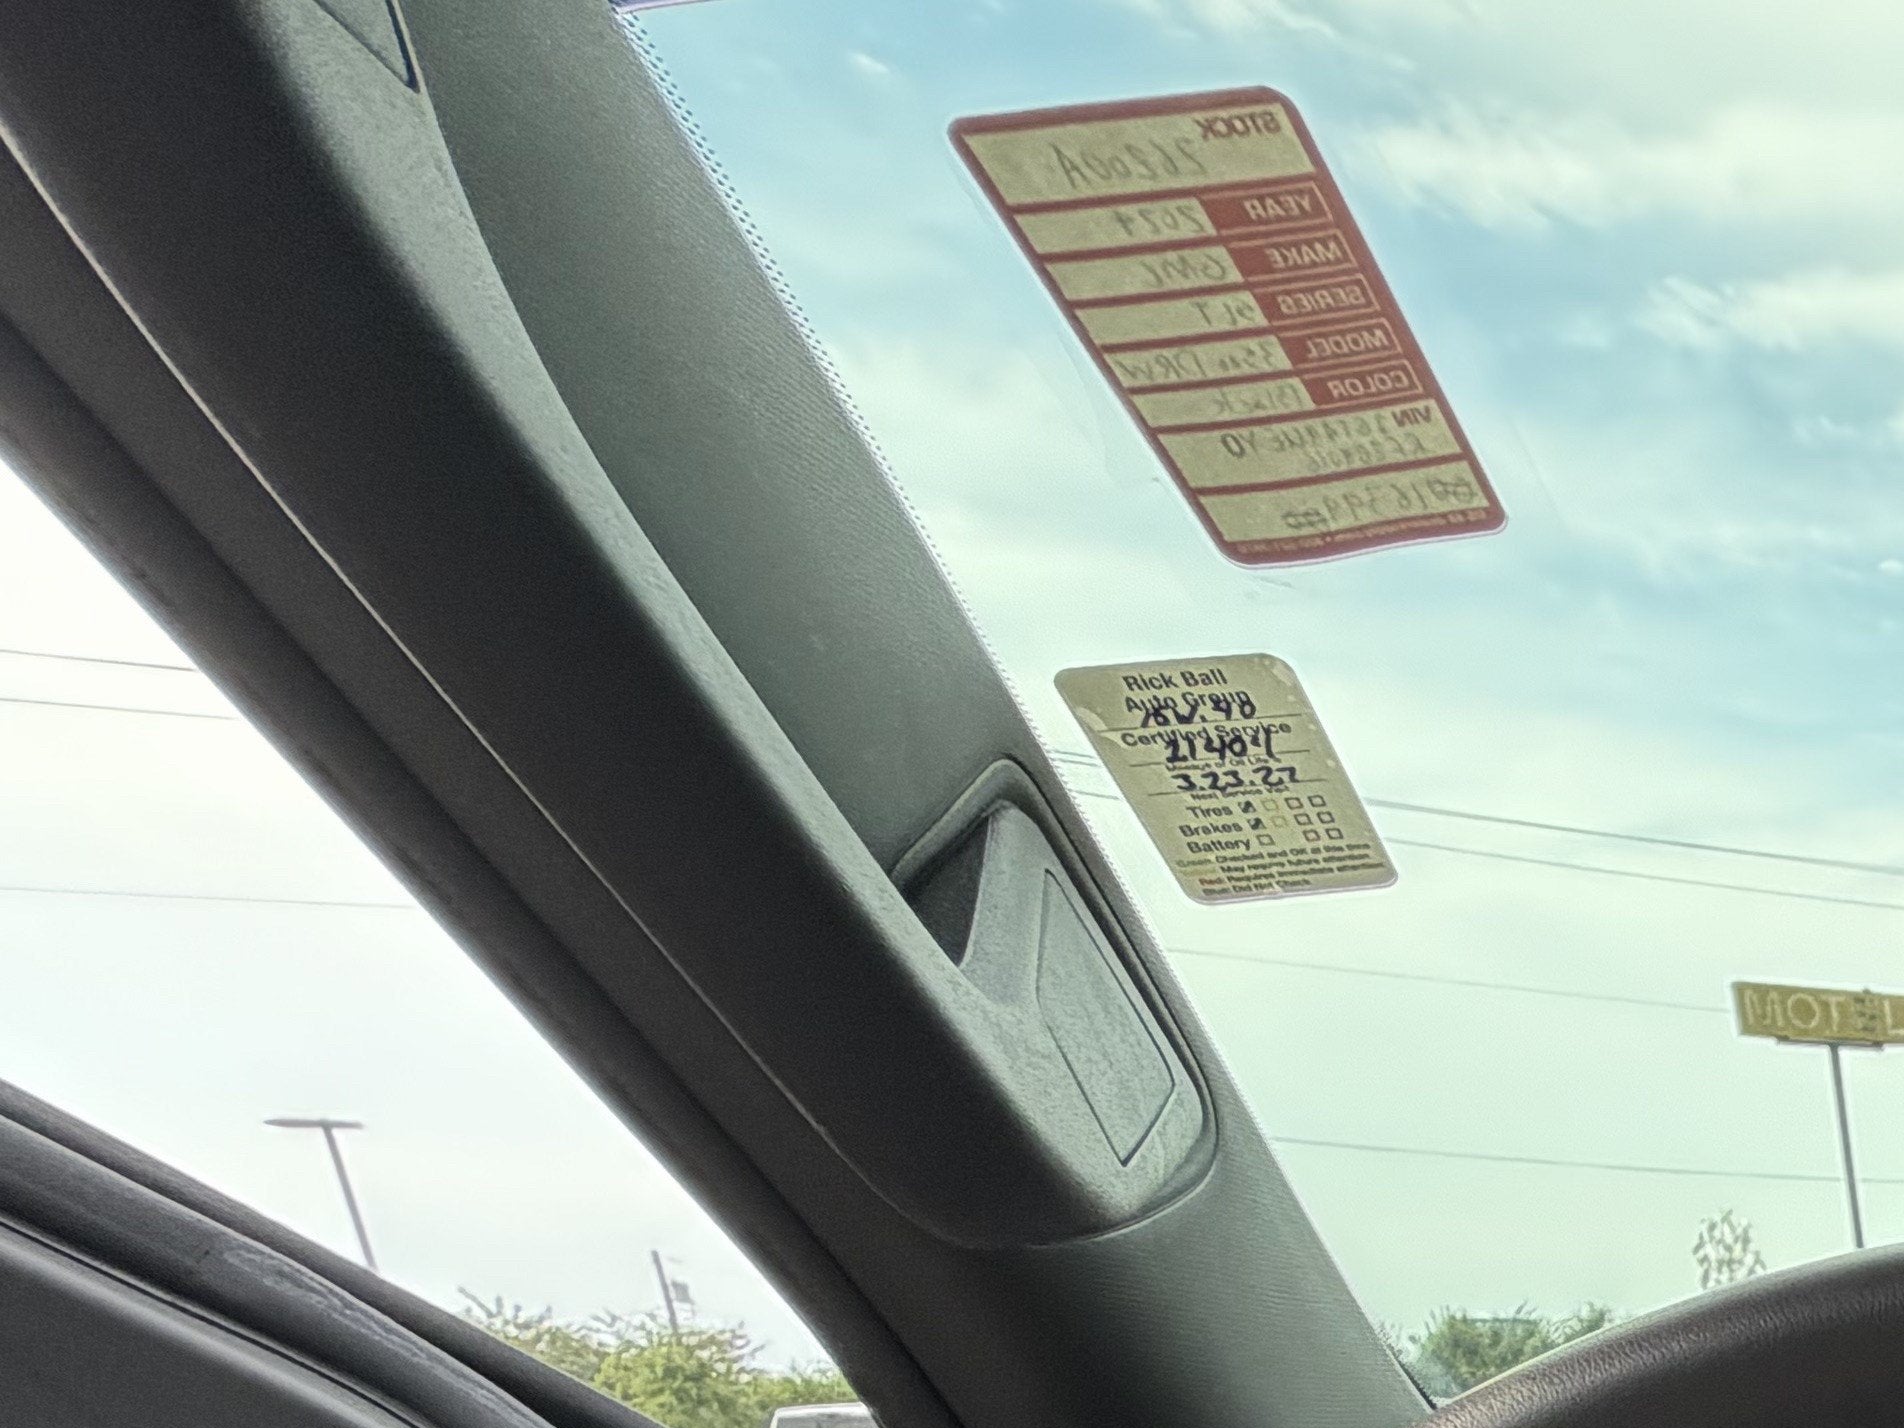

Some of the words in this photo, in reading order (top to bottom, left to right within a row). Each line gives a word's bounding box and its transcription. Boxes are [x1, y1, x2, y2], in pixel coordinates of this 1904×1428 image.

[1122, 671, 1180, 692] Rick
[1180, 667, 1228, 688] Ball
[1124, 693, 1179, 714] Auto
[1186, 804, 1234, 820] Tires
[1178, 820, 1244, 838] Brakes
[1186, 837, 1251, 855] Battery
